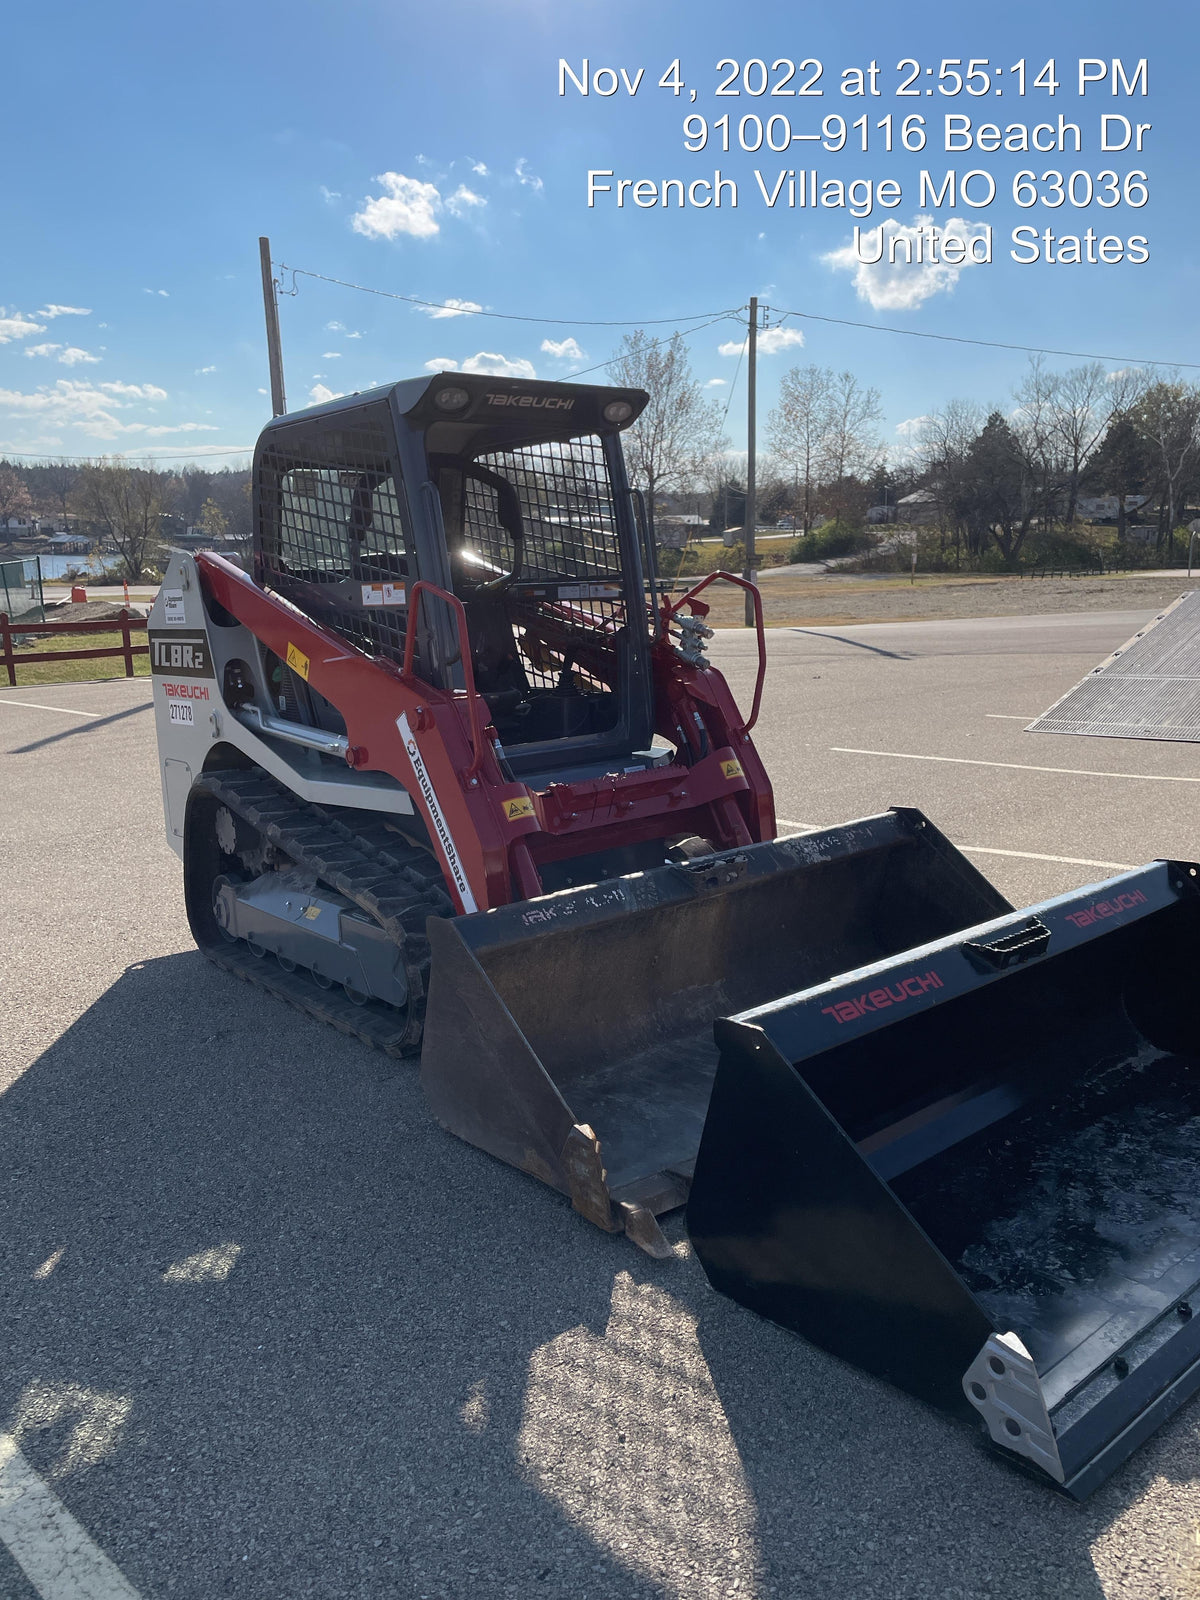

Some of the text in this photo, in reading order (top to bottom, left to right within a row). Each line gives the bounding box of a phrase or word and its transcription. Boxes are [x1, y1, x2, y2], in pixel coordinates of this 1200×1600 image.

[485, 393, 575, 410] TAKEUCHI
[162, 683, 210, 701] TAKEUCHI
[169, 703, 193, 722] 271278
[412, 756, 466, 893] EquipmentShare
[1064, 889, 1148, 928] TAKEUCHI
[821, 970, 944, 1024] TAKEUCHI
